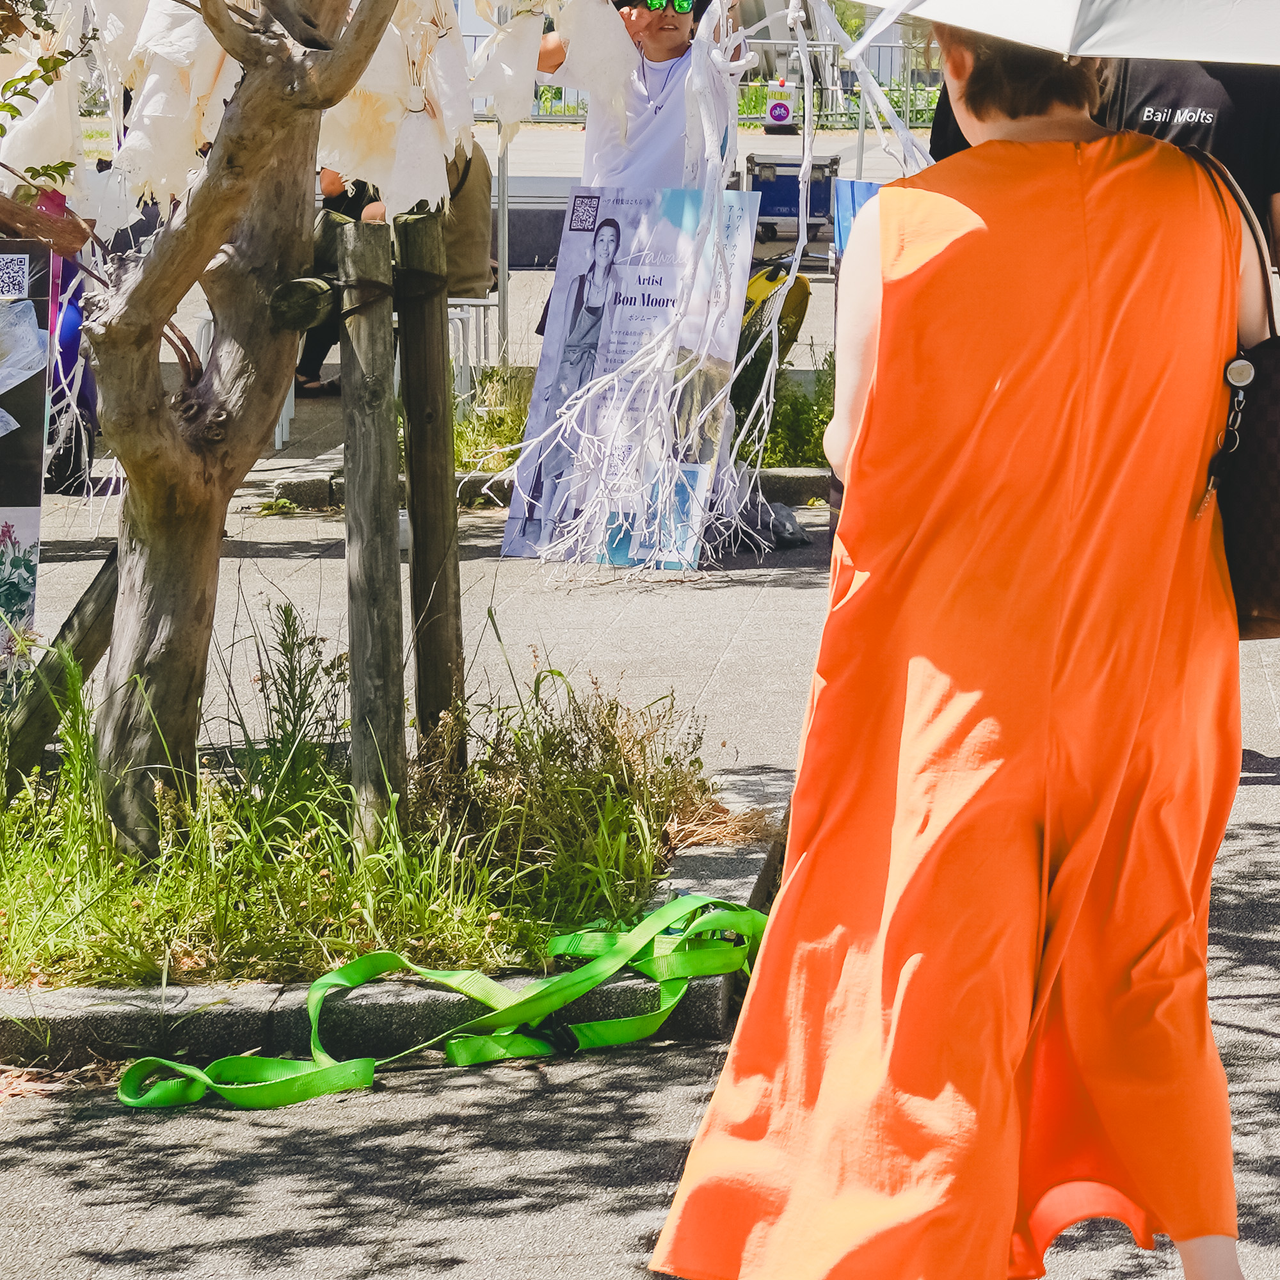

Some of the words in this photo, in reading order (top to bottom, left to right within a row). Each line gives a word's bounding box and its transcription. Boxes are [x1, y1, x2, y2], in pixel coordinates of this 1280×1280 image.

[1143, 107, 1171, 122] Bail
[1173, 108, 1214, 124] Molts
[635, 274, 663, 287] Artist
[612, 291, 638, 307] Bon
